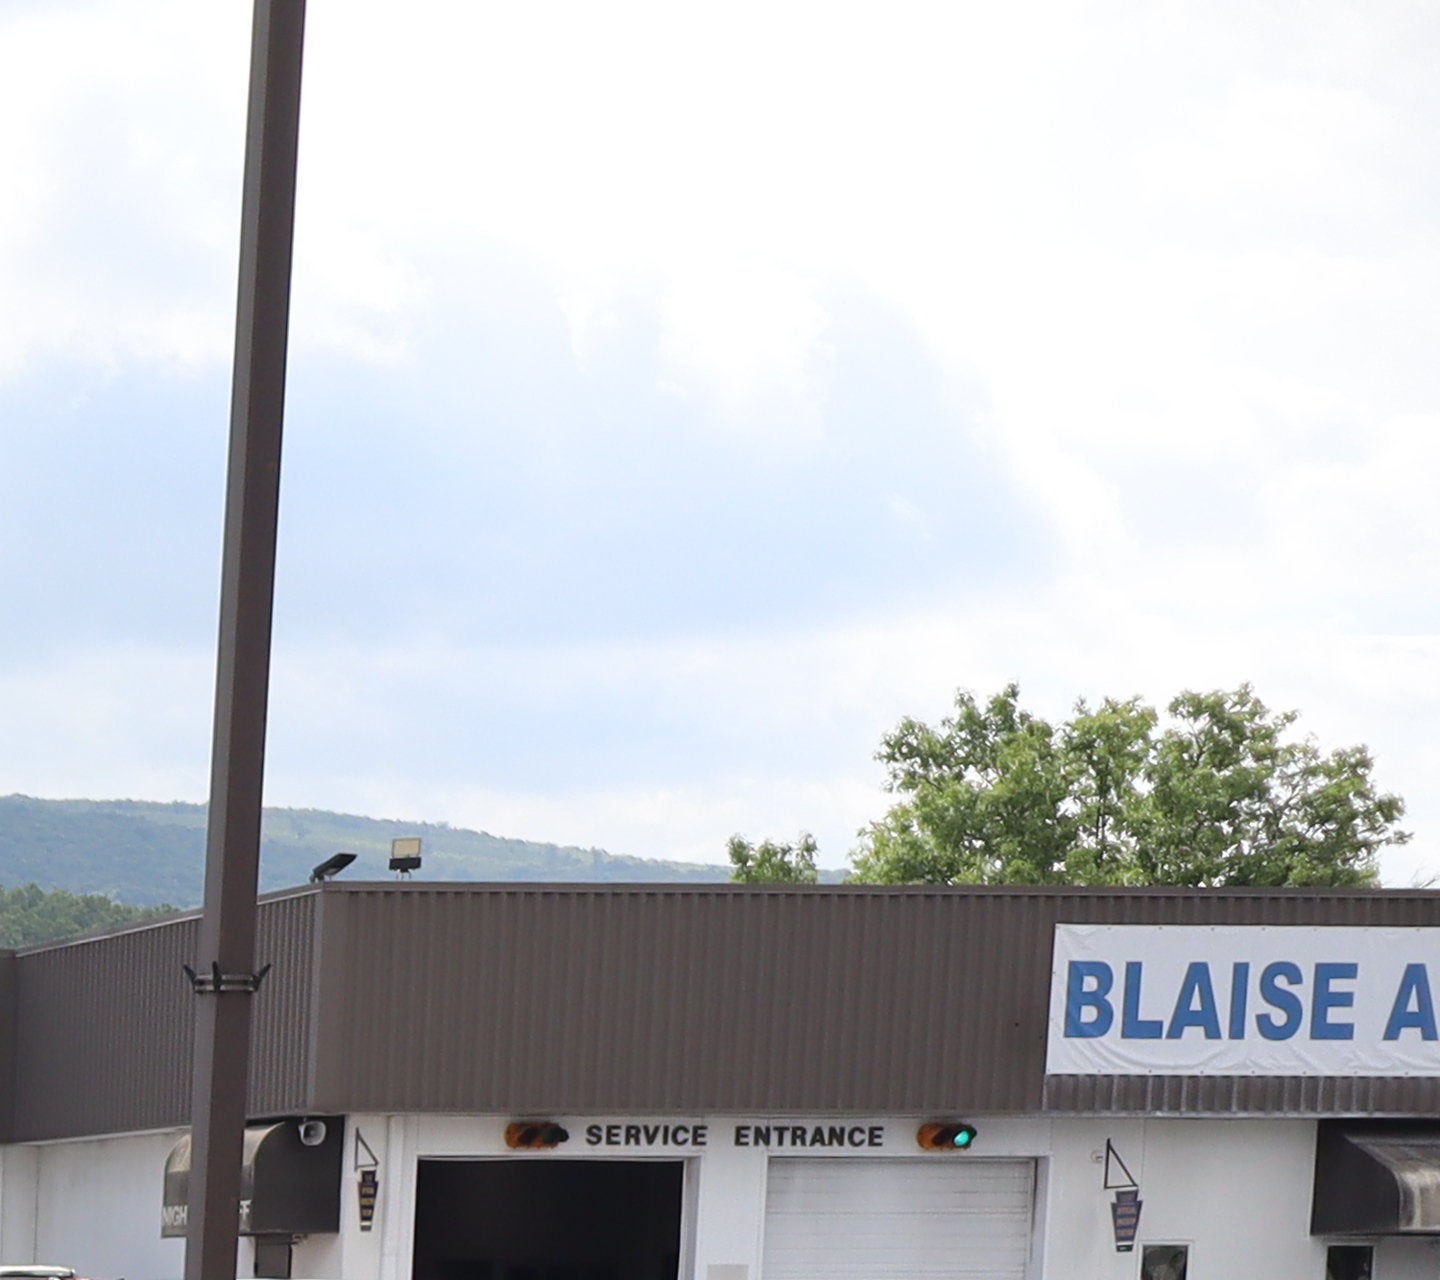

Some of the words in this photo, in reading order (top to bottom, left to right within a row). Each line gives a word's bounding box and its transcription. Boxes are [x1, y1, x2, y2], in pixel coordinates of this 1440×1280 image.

[1063, 960, 1359, 1041] BLAISE
[585, 1124, 709, 1146] SERVICE
[734, 1126, 885, 1147] ENTRANCE
[162, 1204, 189, 1226] NIGH
